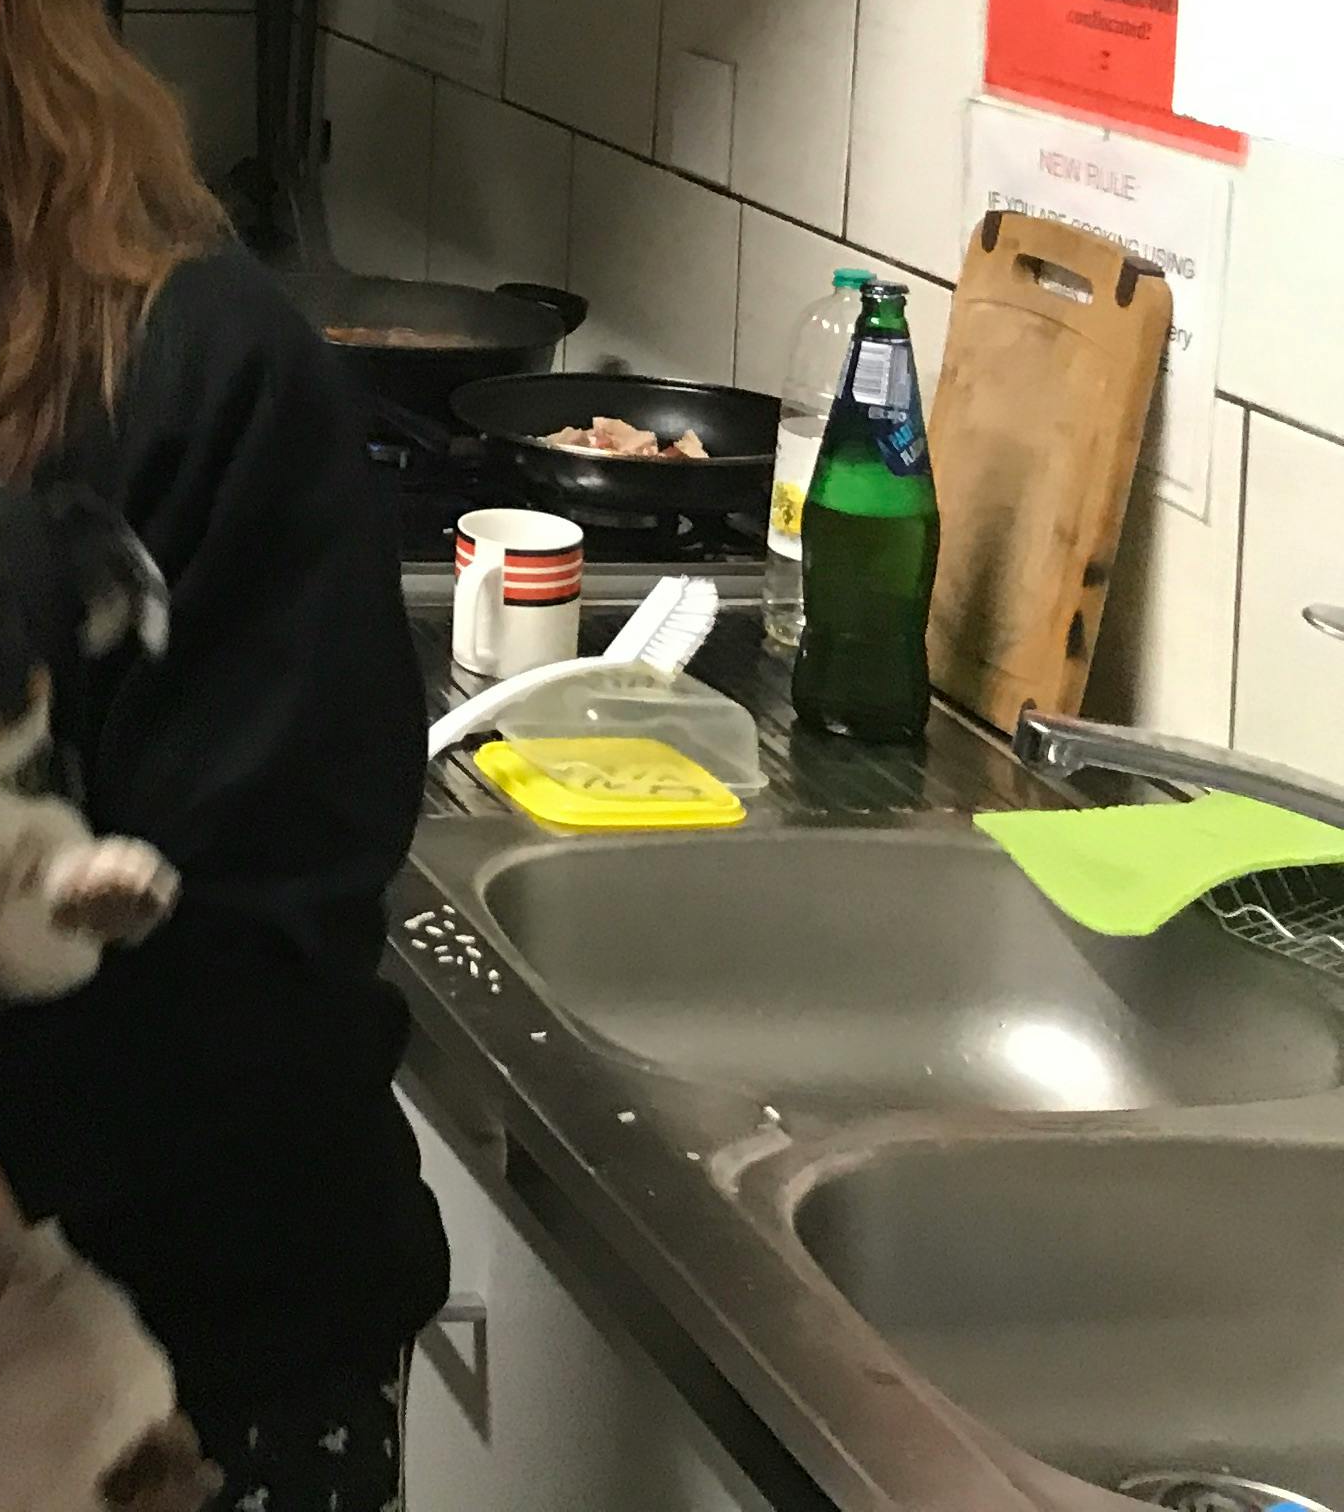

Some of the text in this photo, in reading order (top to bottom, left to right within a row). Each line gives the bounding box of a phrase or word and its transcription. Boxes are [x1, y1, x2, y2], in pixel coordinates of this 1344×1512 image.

[1039, 148, 1081, 182] NEW
[987, 190, 1001, 211] IF
[1144, 243, 1196, 280] USING
[1168, 325, 1193, 352] ery
